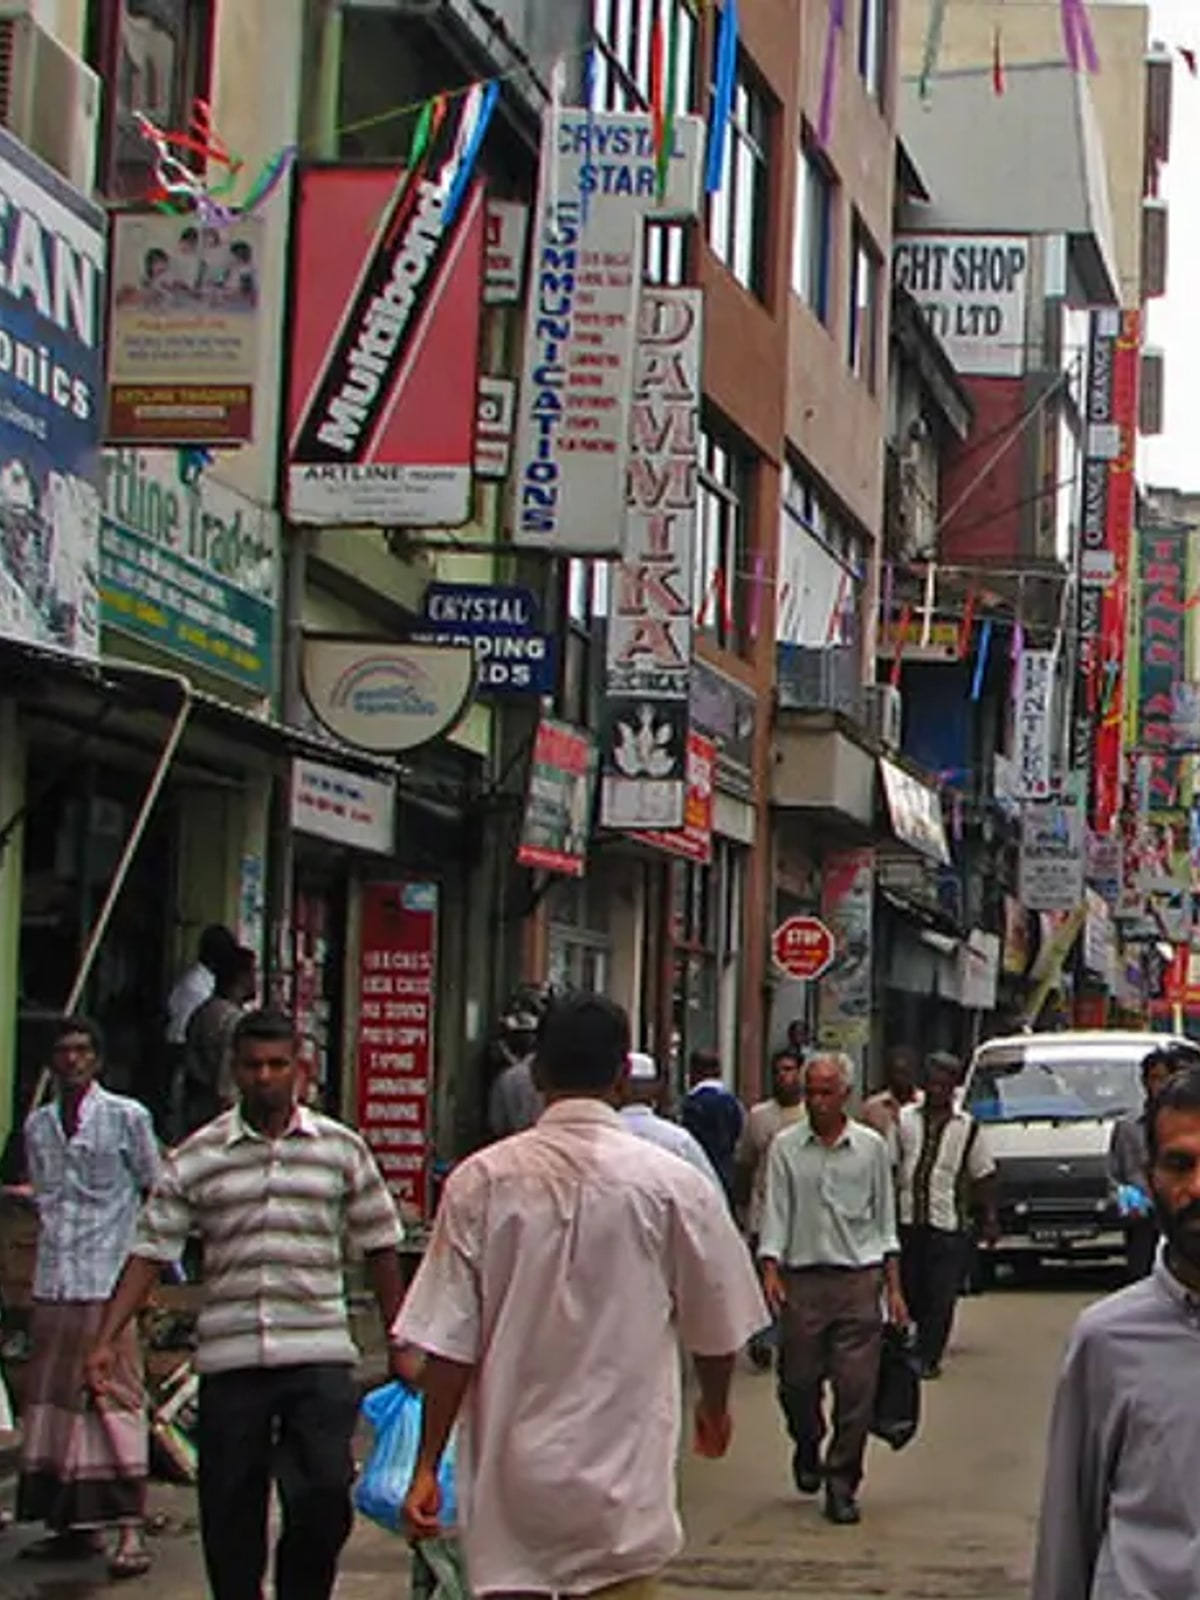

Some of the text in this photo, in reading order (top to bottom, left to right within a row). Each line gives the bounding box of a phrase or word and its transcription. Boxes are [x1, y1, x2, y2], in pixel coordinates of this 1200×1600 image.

[558, 123, 686, 159] CRYSTL
[579, 164, 656, 196] STAR
[0, 190, 97, 350] AN
[953, 246, 1026, 292] SHOP
[316, 170, 447, 456] Multibond
[956, 305, 1003, 337] LTD
[302, 464, 400, 482] ARTLINE
[614, 298, 699, 669] DAMMIKA
[428, 594, 529, 625] CRYSTAL
[786, 928, 822, 946] STOP
